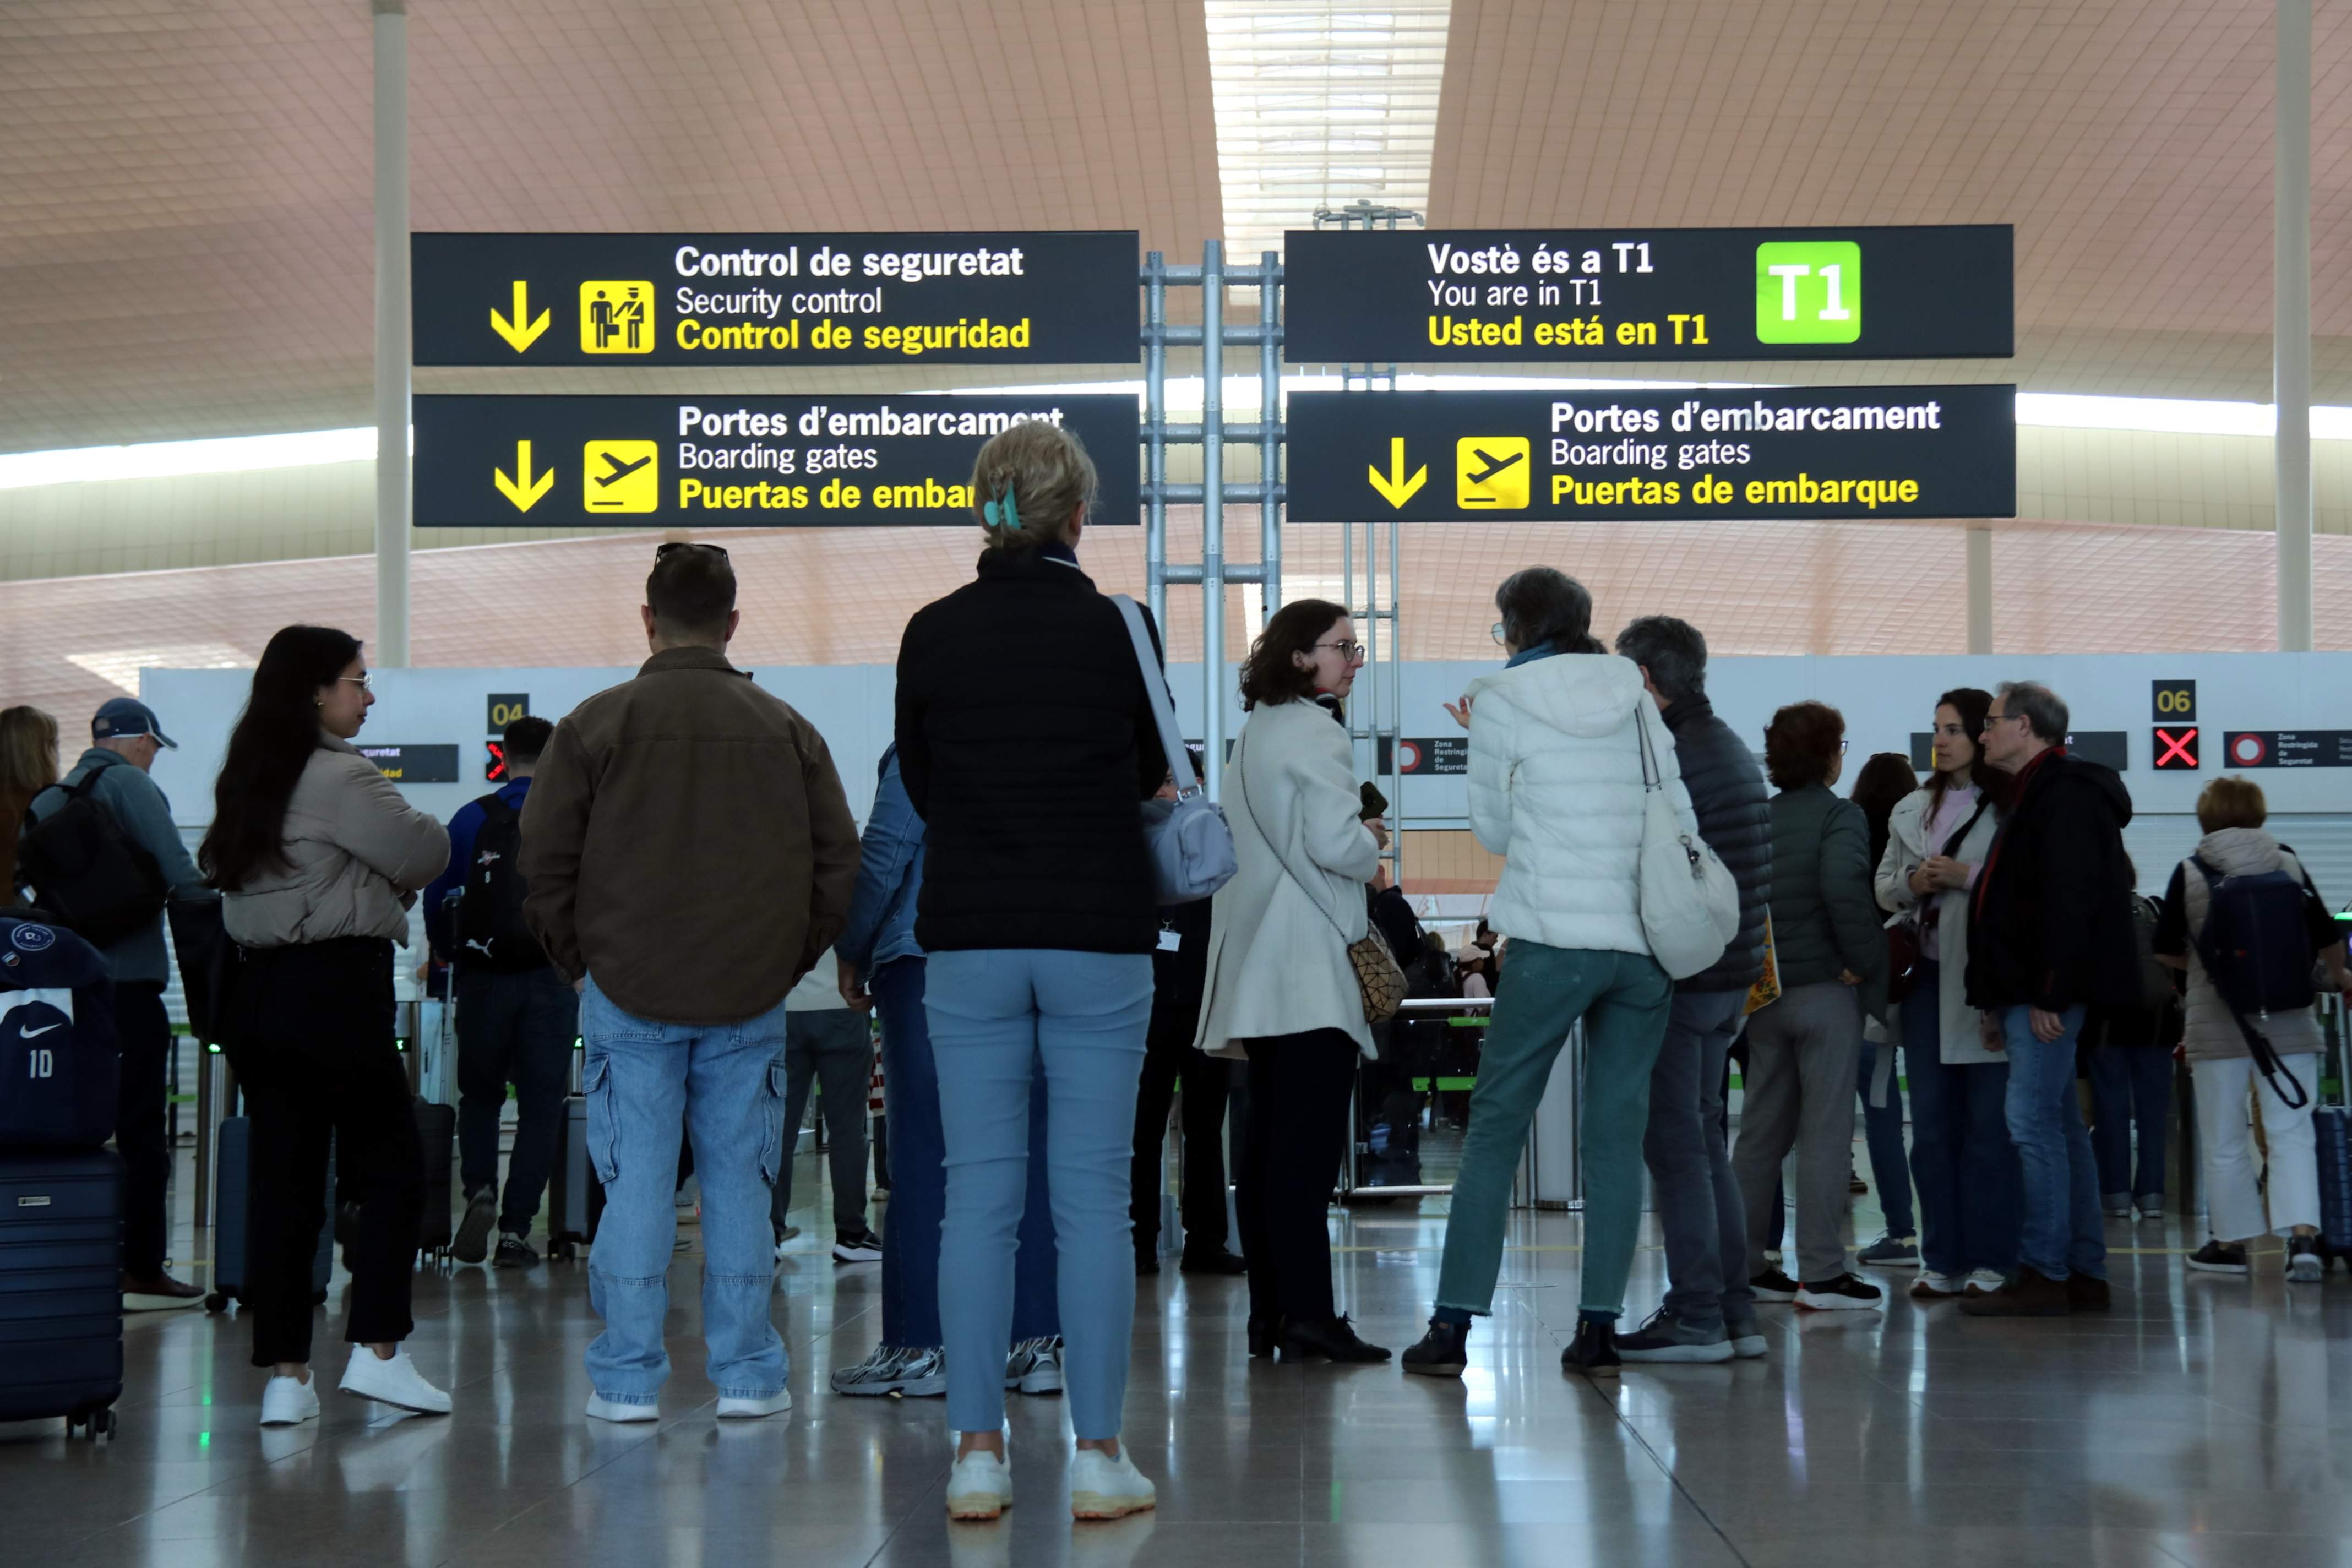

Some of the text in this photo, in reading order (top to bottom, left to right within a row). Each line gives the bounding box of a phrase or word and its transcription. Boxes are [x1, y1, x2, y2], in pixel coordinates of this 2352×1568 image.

[675, 246, 1024, 283] Control de seguretat
[1427, 242, 1653, 274] Vostè és a T1
[676, 286, 881, 319] Security control
[1427, 279, 1602, 307] You are in T1
[1768, 264, 1850, 320] T1
[676, 318, 1030, 355] Control de seguridad
[1429, 314, 1709, 346] Usted está en T1
[679, 406, 788, 437] Portes
[1551, 400, 1941, 433] Portes d'embarcament
[679, 442, 878, 474] Boarding gates
[1551, 438, 1751, 470] Boarding gates
[679, 478, 976, 509] Puertas de embar
[1551, 473, 1919, 510] Puertas de embarque
[492, 703, 522, 726] 04
[2157, 690, 2191, 712] 06
[1435, 748, 1467, 756] Restringi
[1435, 764, 1467, 772] Segureta
[29, 1049, 53, 1079] 10
